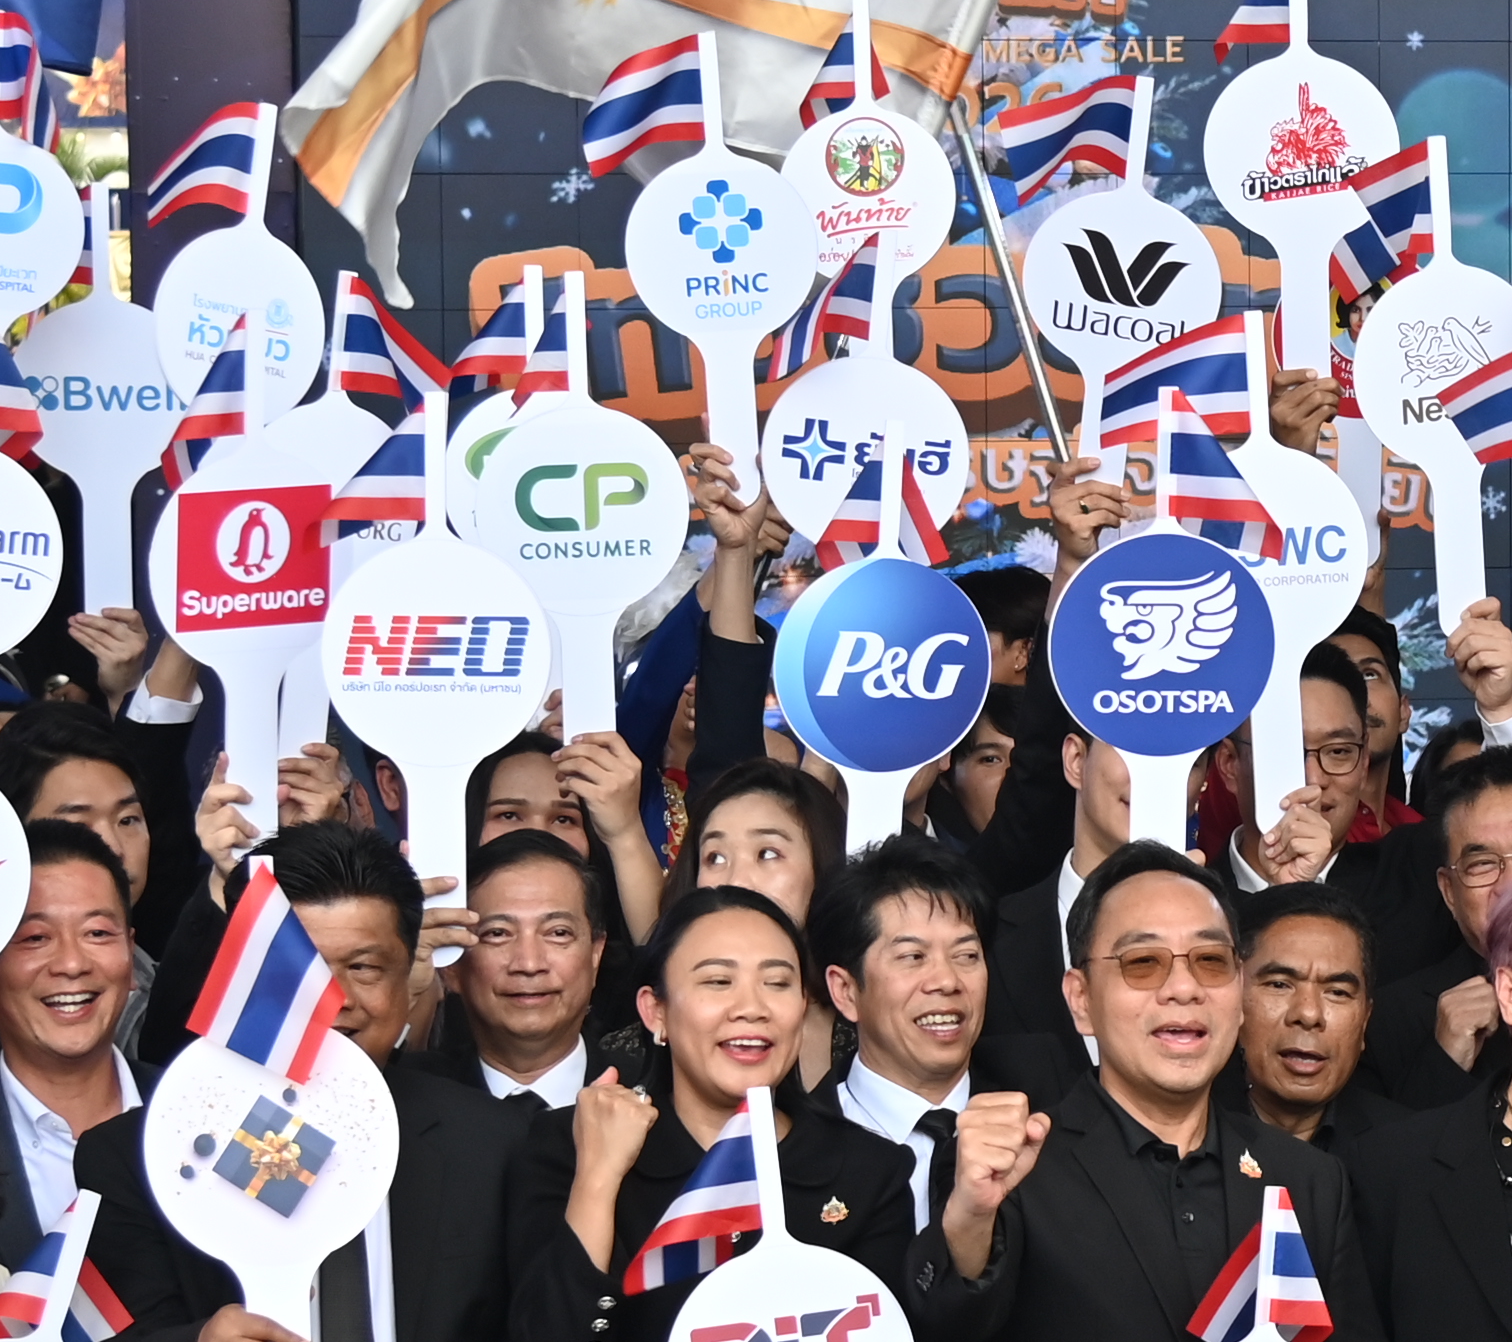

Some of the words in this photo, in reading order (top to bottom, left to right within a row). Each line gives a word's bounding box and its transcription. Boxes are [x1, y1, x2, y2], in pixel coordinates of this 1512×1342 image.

[982, 35, 1085, 64] MEGA
[1100, 35, 1186, 64] SALE
[695, 300, 763, 320] GROUP
[514, 462, 650, 533] CP
[519, 538, 652, 562] CONSUMER
[1263, 572, 1350, 589] CORPORATION
[181, 587, 327, 620] Superware
[342, 615, 531, 678] NEO
[815, 629, 971, 701] P&G
[341, 680, 371, 694] บริษัท
[373, 680, 392, 694] นีโอ
[449, 681, 479, 696] จำกัด
[480, 682, 523, 696] (มหาชน)
[1092, 689, 1235, 714] OSOTSPA
